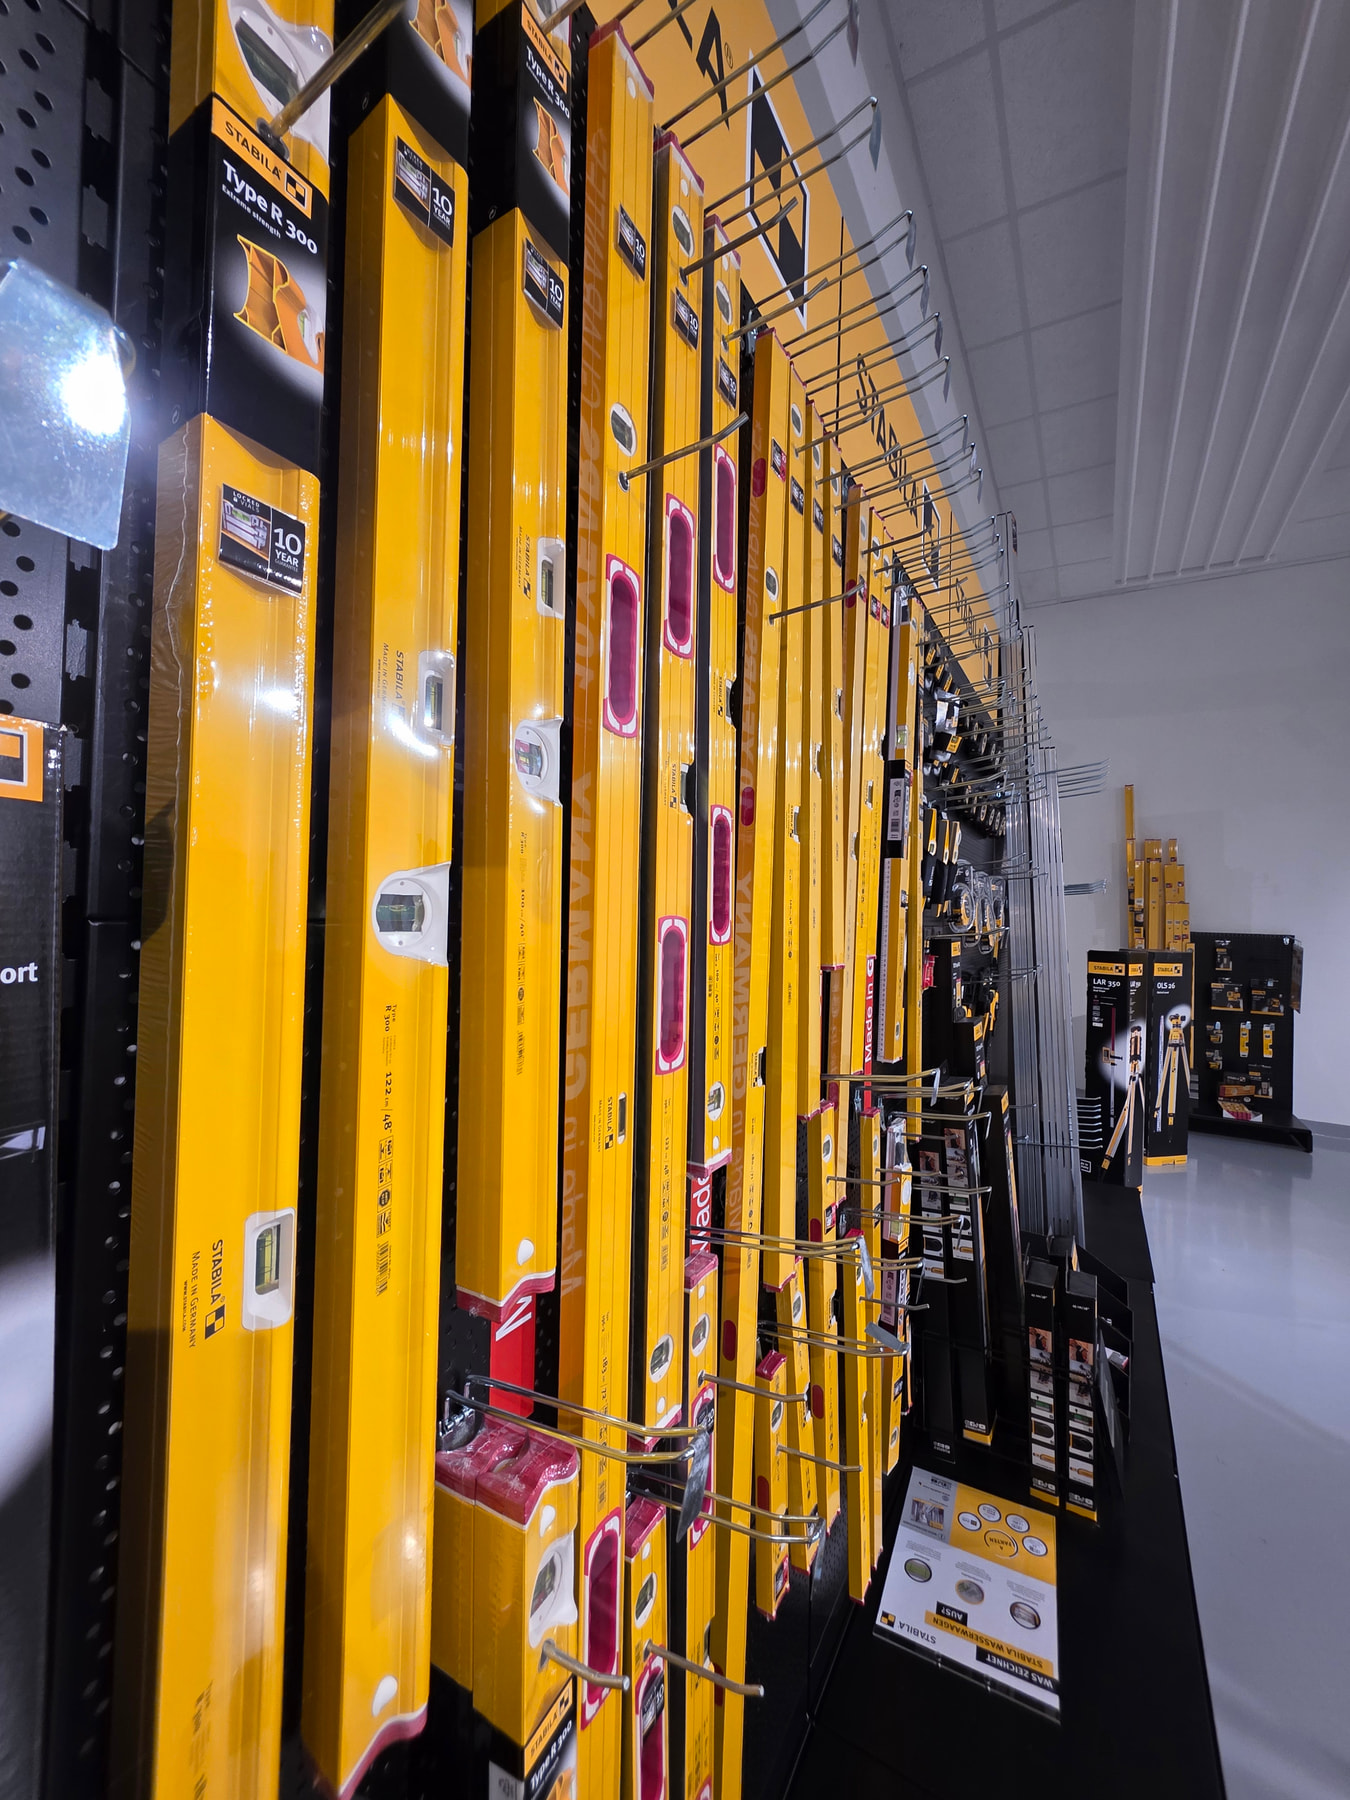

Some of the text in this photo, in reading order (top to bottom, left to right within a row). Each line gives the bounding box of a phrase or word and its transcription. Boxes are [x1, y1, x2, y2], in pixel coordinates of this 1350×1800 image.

[526, 19, 553, 64] STABILA
[526, 45, 548, 86] Type
[547, 78, 555, 96] R
[554, 91, 570, 119] 300
[225, 120, 282, 181] STABILA
[221, 183, 282, 239] Extreme strength
[222, 159, 318, 254] Type R 300
[432, 187, 453, 216] 10
[433, 203, 452, 226] YEAR
[635, 238, 645, 259] 10
[549, 278, 563, 302] 10
[689, 313, 699, 332] 10
[232, 490, 261, 508] LOCKED
[240, 499, 261, 514] VIALS
[273, 527, 302, 556] 10
[275, 549, 299, 568] YEAR
[395, 649, 405, 700] STABILA
[0, 962, 38, 984] ort
[1093, 978, 1121, 988] LAR 350
[1156, 982, 1168, 990] OLS
[866, 982, 874, 1000] in
[386, 1004, 392, 1012] R
[864, 1006, 873, 1063] Made
[191, 1250, 201, 1283] MADE
[210, 1238, 224, 1306] STABILA
[189, 1297, 200, 1349] GERMANY
[940, 1606, 963, 1622] AUS?
[898, 1620, 937, 1645] STABILA
[932, 1616, 1043, 1668] STABILA WASSERWAAGEN
[985, 1653, 1054, 1689] WAS ZEICHNET
[530, 1711, 558, 1758] STABILA
[530, 1755, 550, 1792] Type
[550, 1741, 557, 1760] R
[557, 1720, 572, 1752] 300
